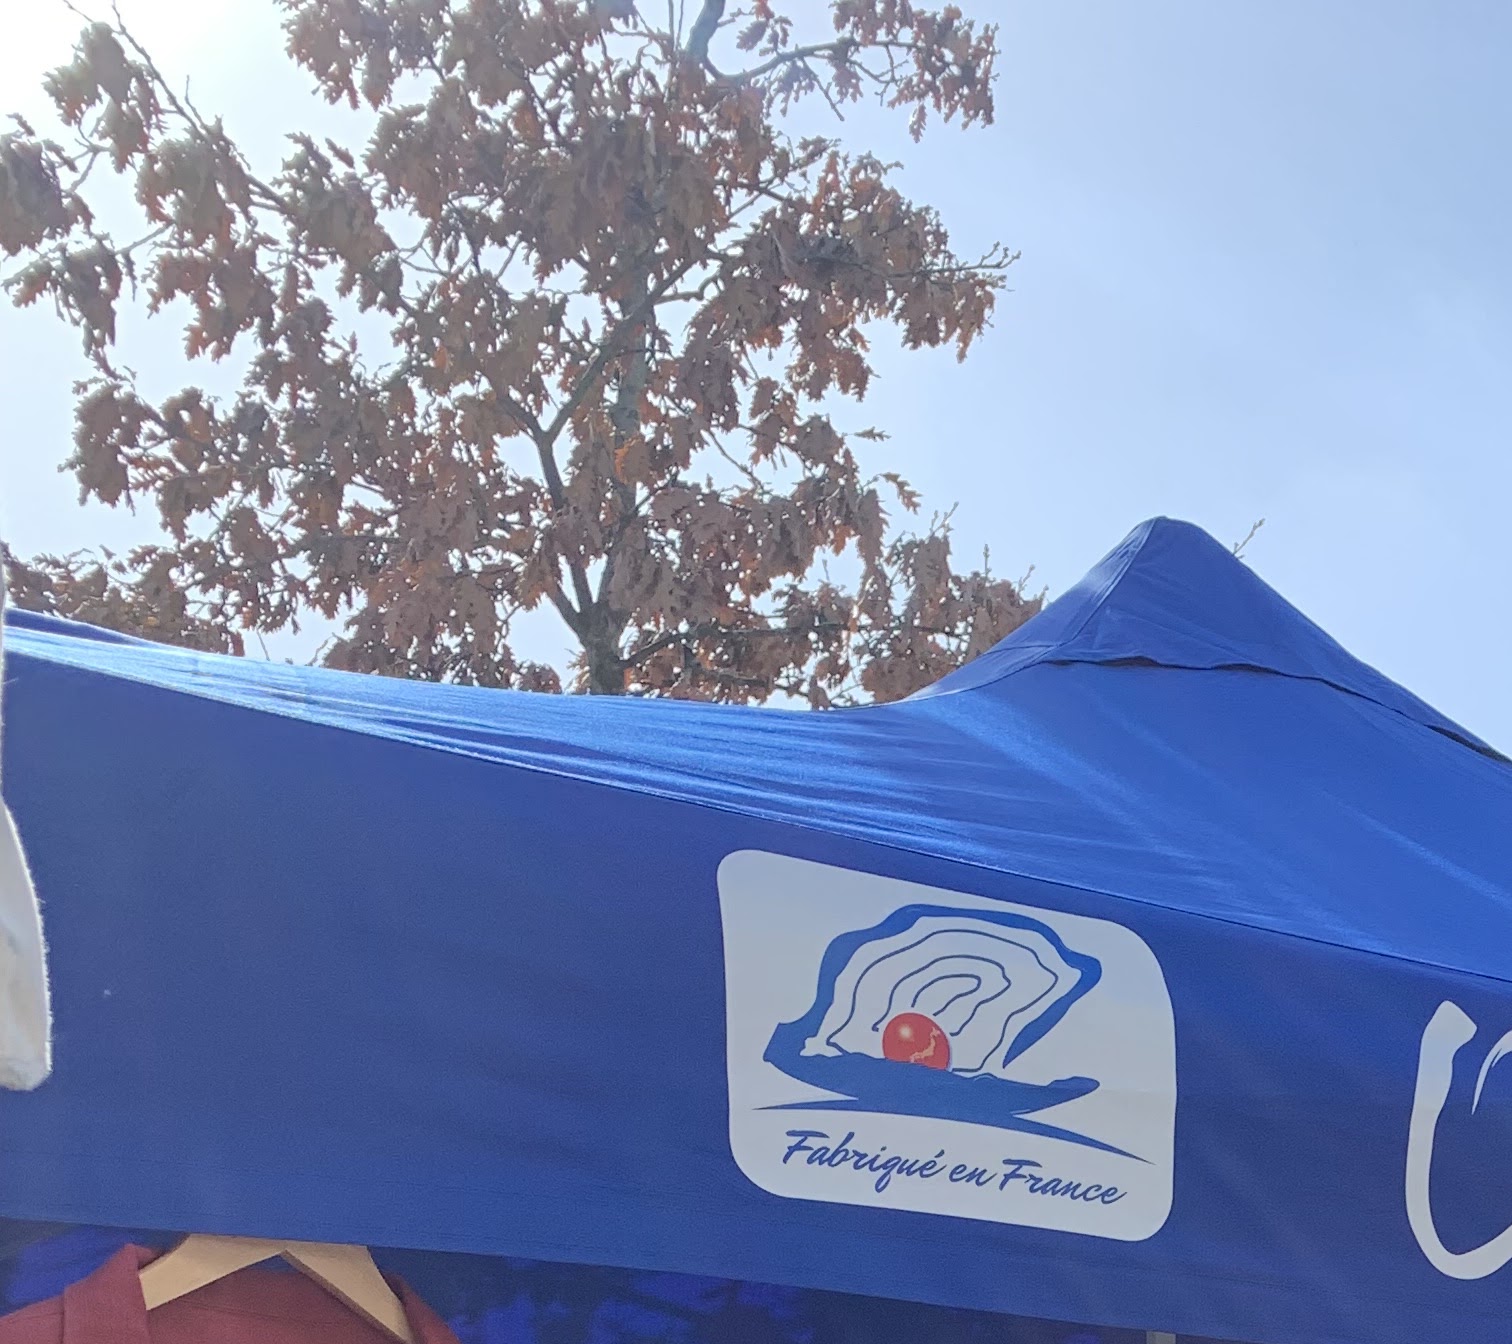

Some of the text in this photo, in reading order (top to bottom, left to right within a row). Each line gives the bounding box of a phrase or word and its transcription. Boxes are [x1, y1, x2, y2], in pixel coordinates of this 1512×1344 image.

[783, 1130, 1128, 1206] Fabriqué en France
